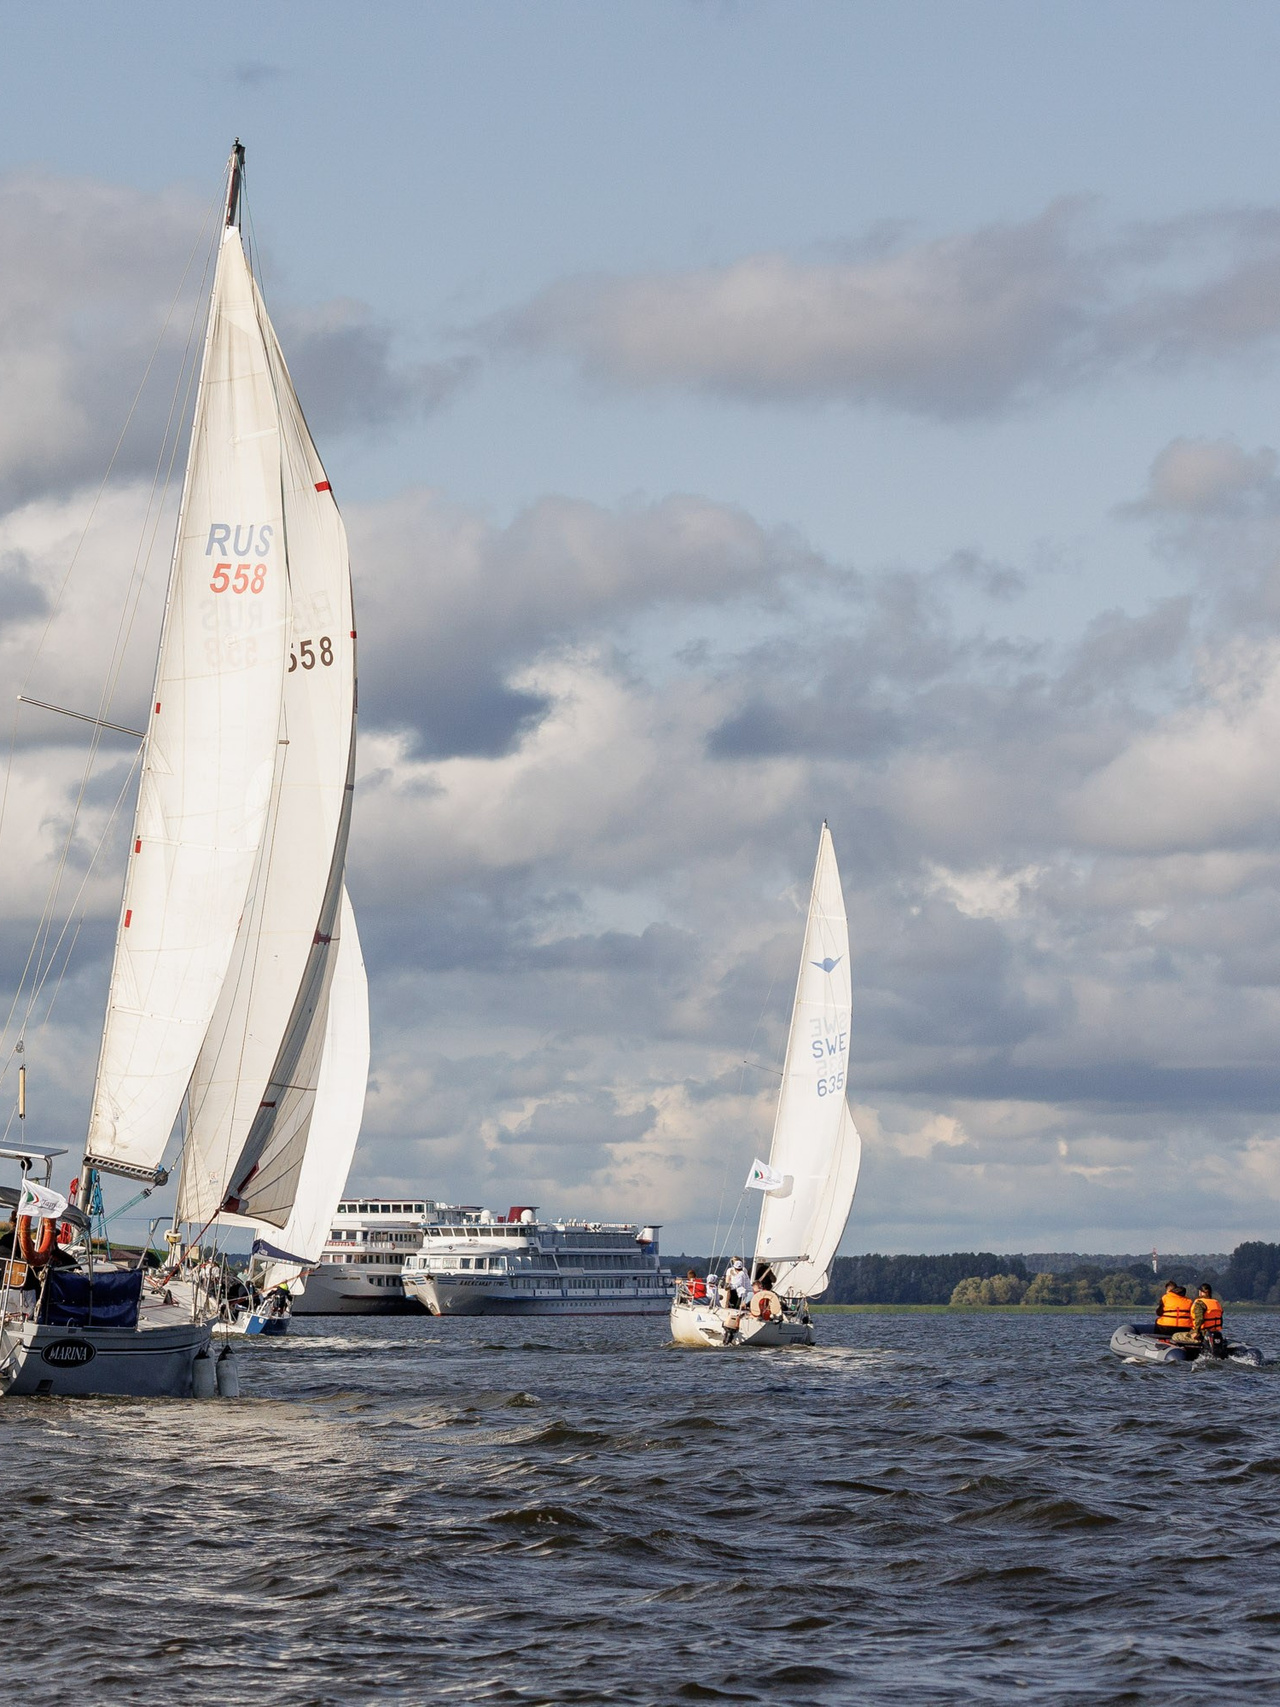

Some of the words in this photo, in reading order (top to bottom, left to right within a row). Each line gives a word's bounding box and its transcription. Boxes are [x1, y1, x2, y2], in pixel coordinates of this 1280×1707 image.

[205, 523, 273, 557] RUS
[209, 563, 267, 594] 558
[812, 1032, 847, 1058] SWE
[817, 1072, 844, 1097] 635
[48, 1346, 87, 1360] MARINA
